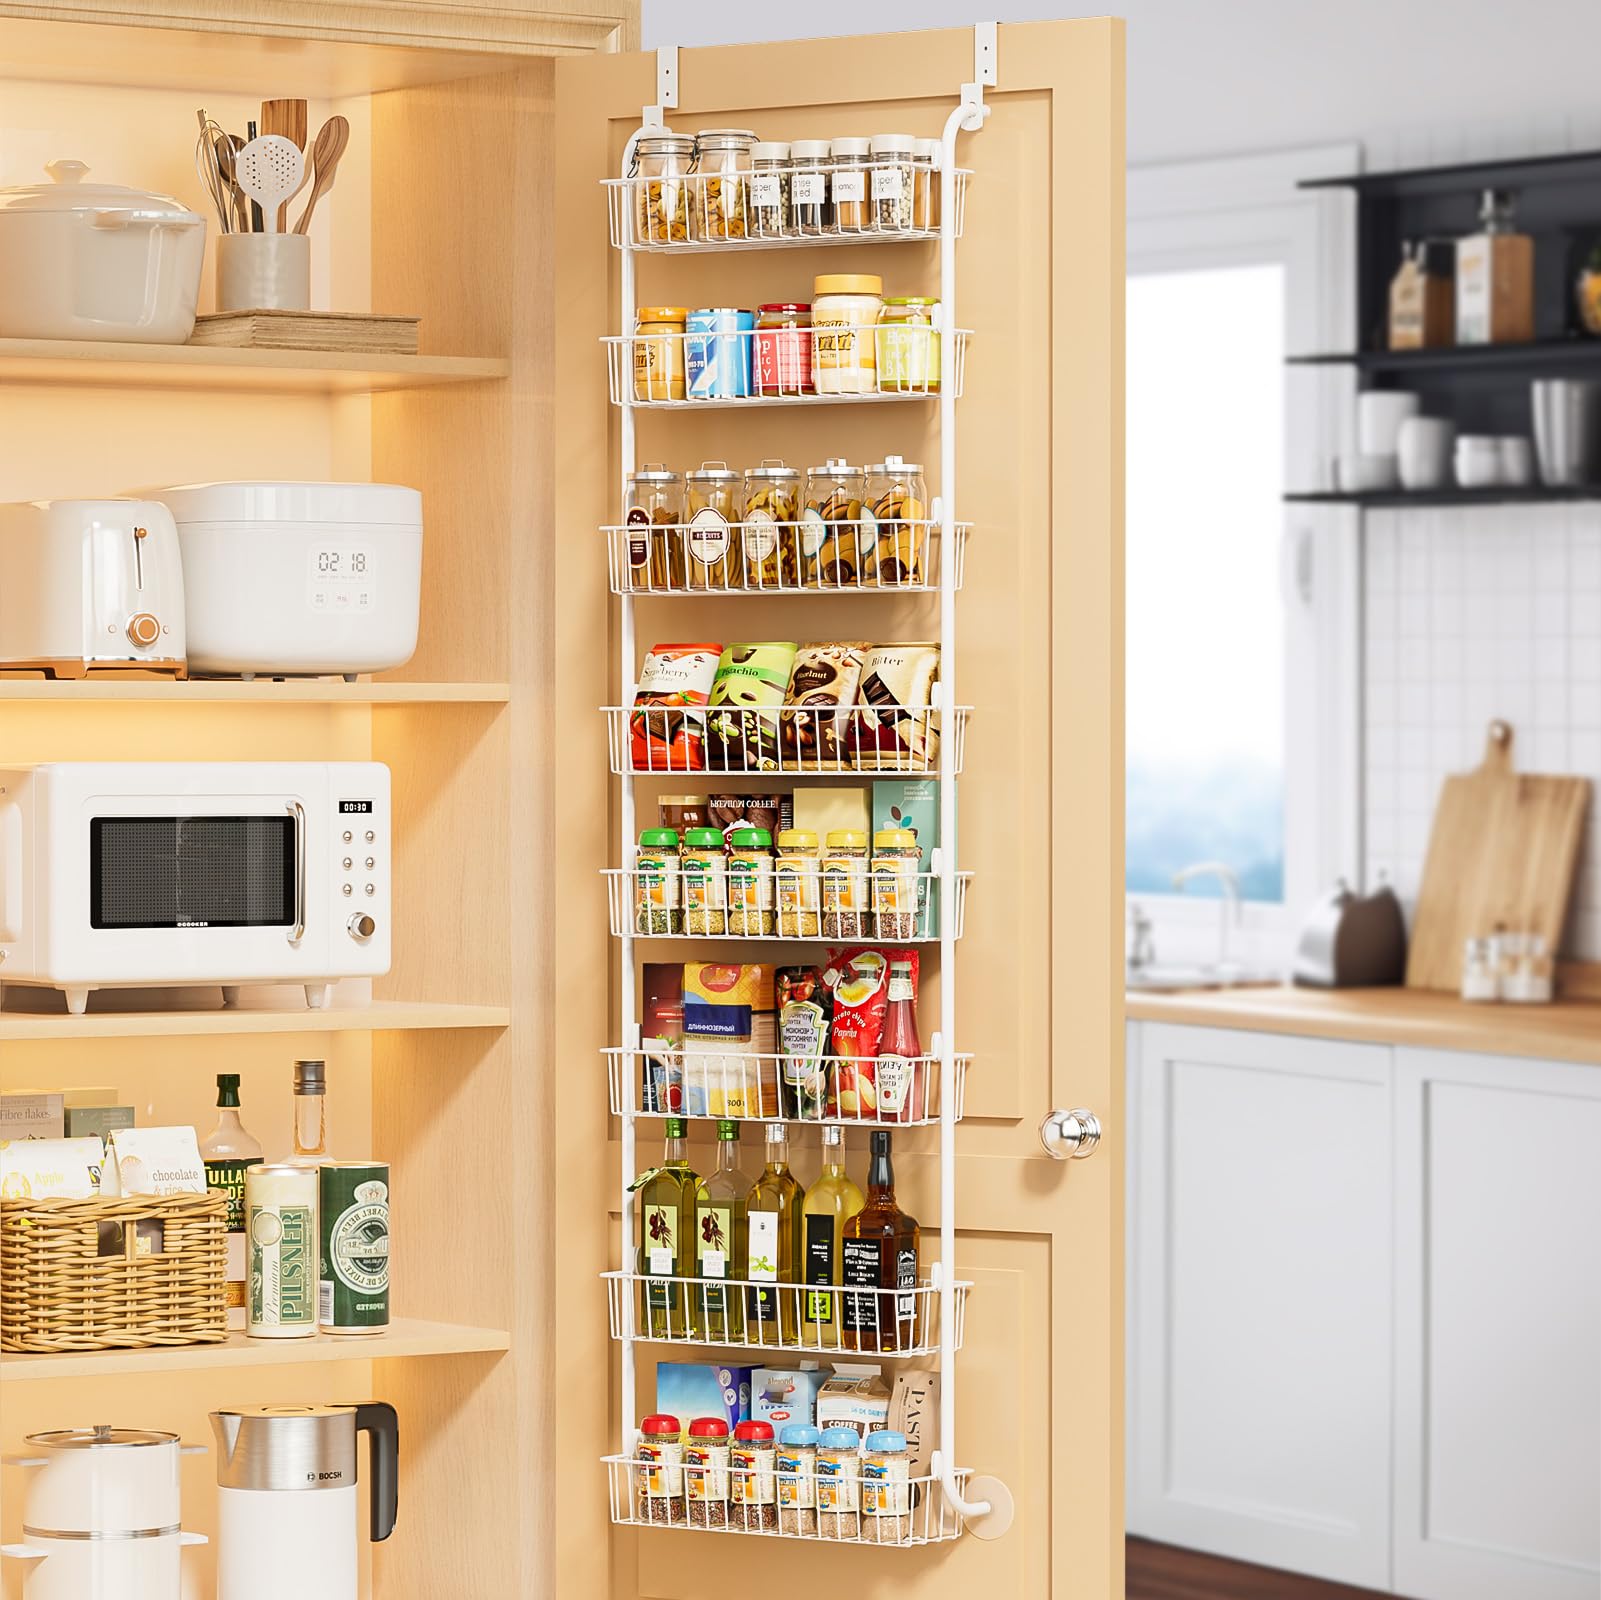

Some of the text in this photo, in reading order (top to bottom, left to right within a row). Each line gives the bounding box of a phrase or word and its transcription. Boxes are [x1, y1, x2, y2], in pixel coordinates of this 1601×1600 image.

[344, 803, 367, 811] 00:30
[0, 1107, 51, 1120] Fibre flakes
[152, 1169, 199, 1182] chocolate
[281, 1211, 303, 1319] PILSNER
[264, 1260, 279, 1324] Premium
[829, 1421, 858, 1429] COFFEE
[905, 1390, 926, 1465] PASTA
[318, 1471, 342, 1480] BOCSH
